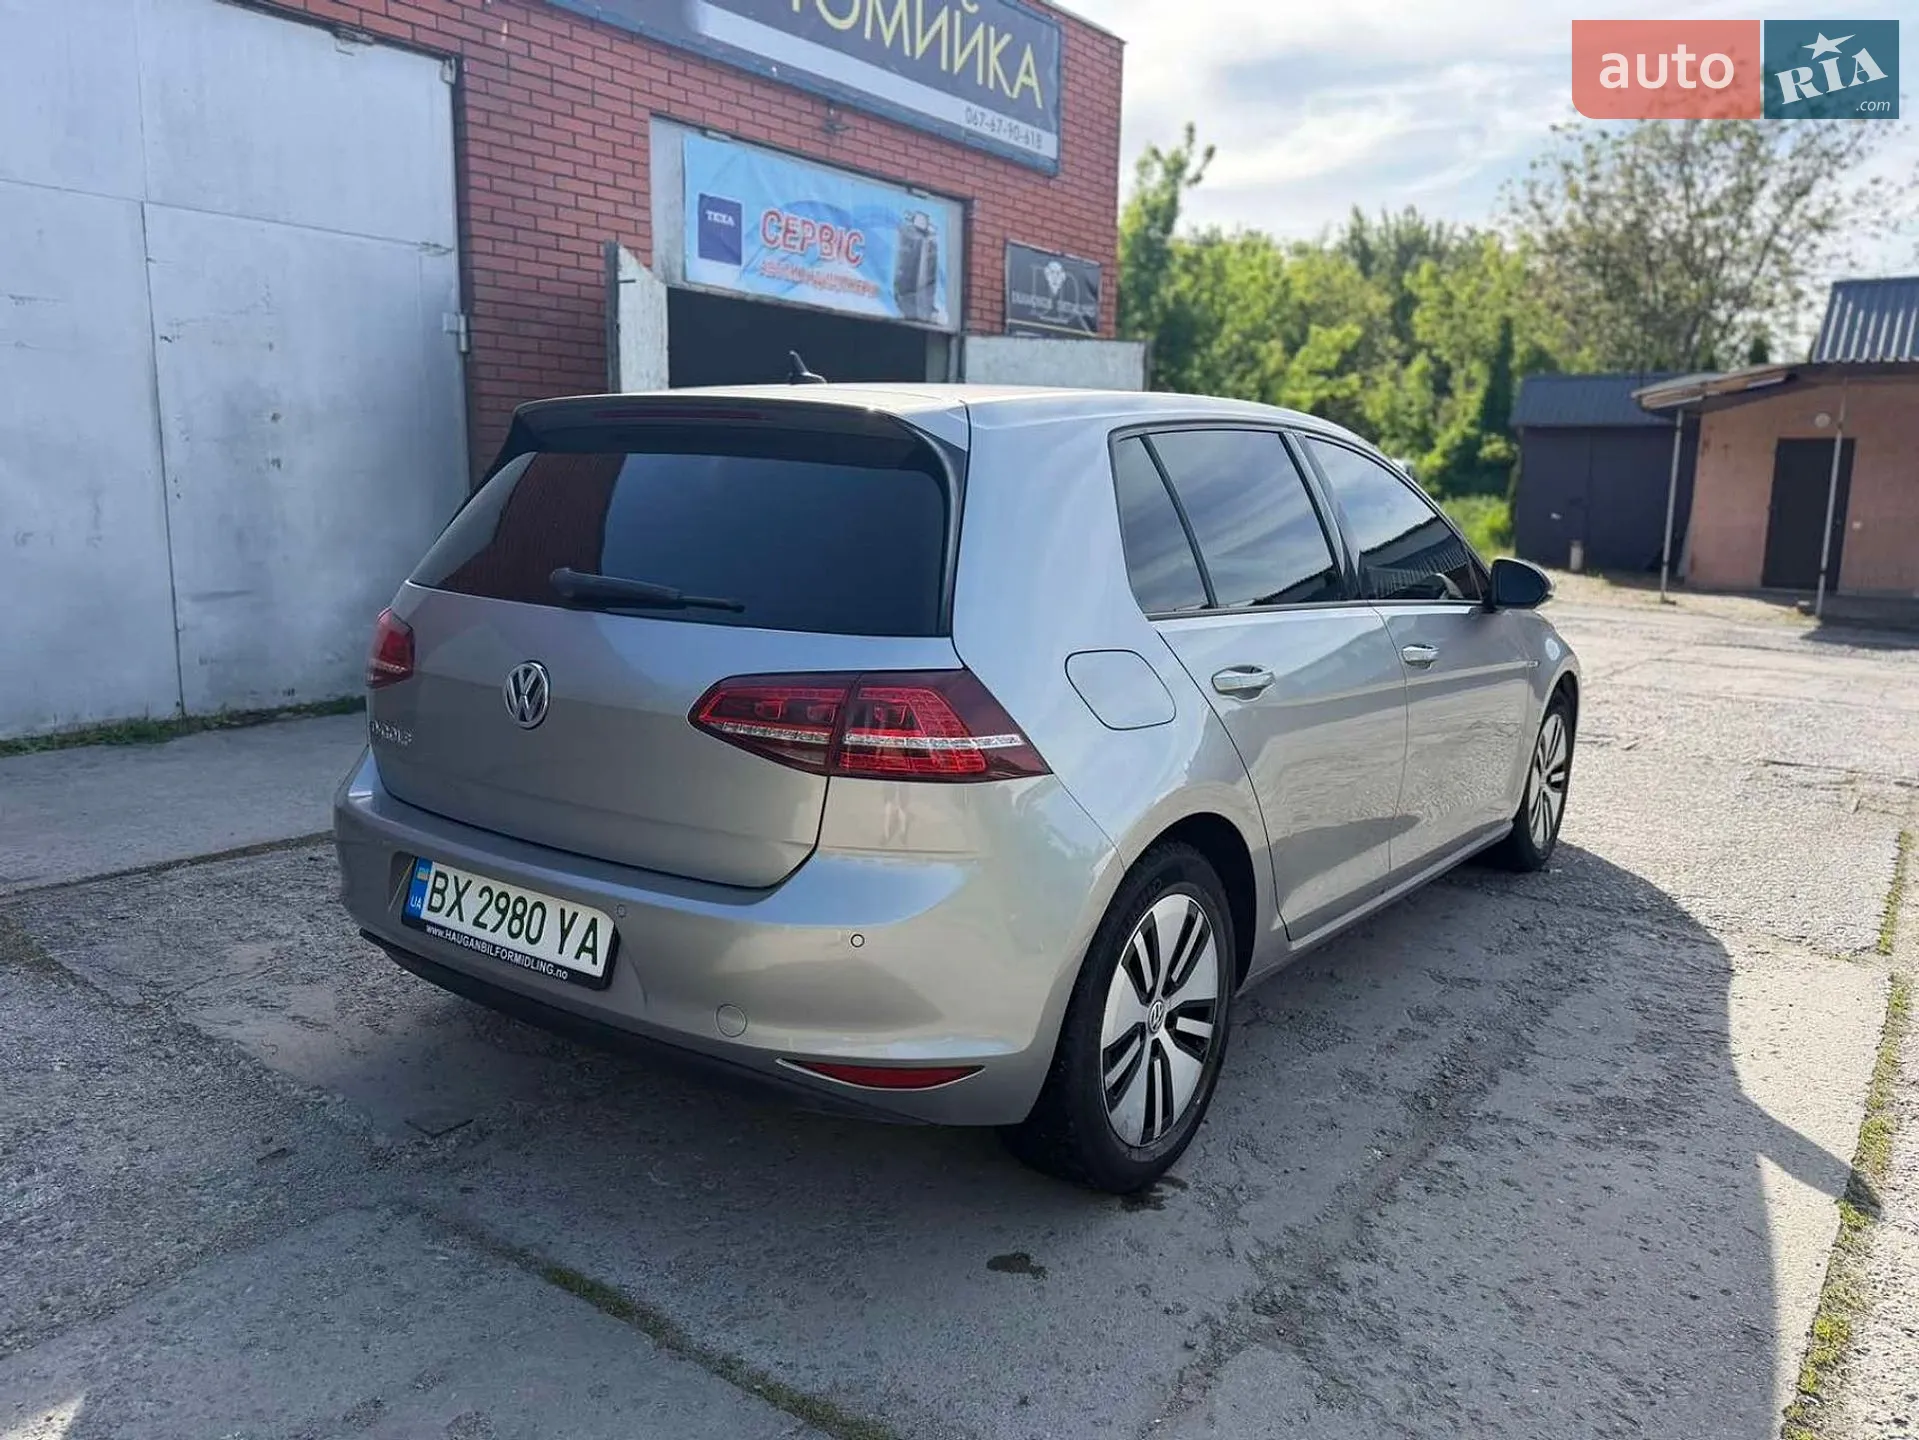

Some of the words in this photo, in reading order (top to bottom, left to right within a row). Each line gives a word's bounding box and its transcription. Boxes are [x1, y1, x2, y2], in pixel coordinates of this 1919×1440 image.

[791, 0, 1043, 109] ОМИЙКА
[761, 209, 865, 267] СЕРВІС
[410, 895, 423, 911] UA
[427, 870, 472, 923] BX
[472, 885, 547, 946] 2980
[559, 907, 599, 966] YA
[426, 924, 569, 982] www.HAUGANBILFORMIDLING.no
